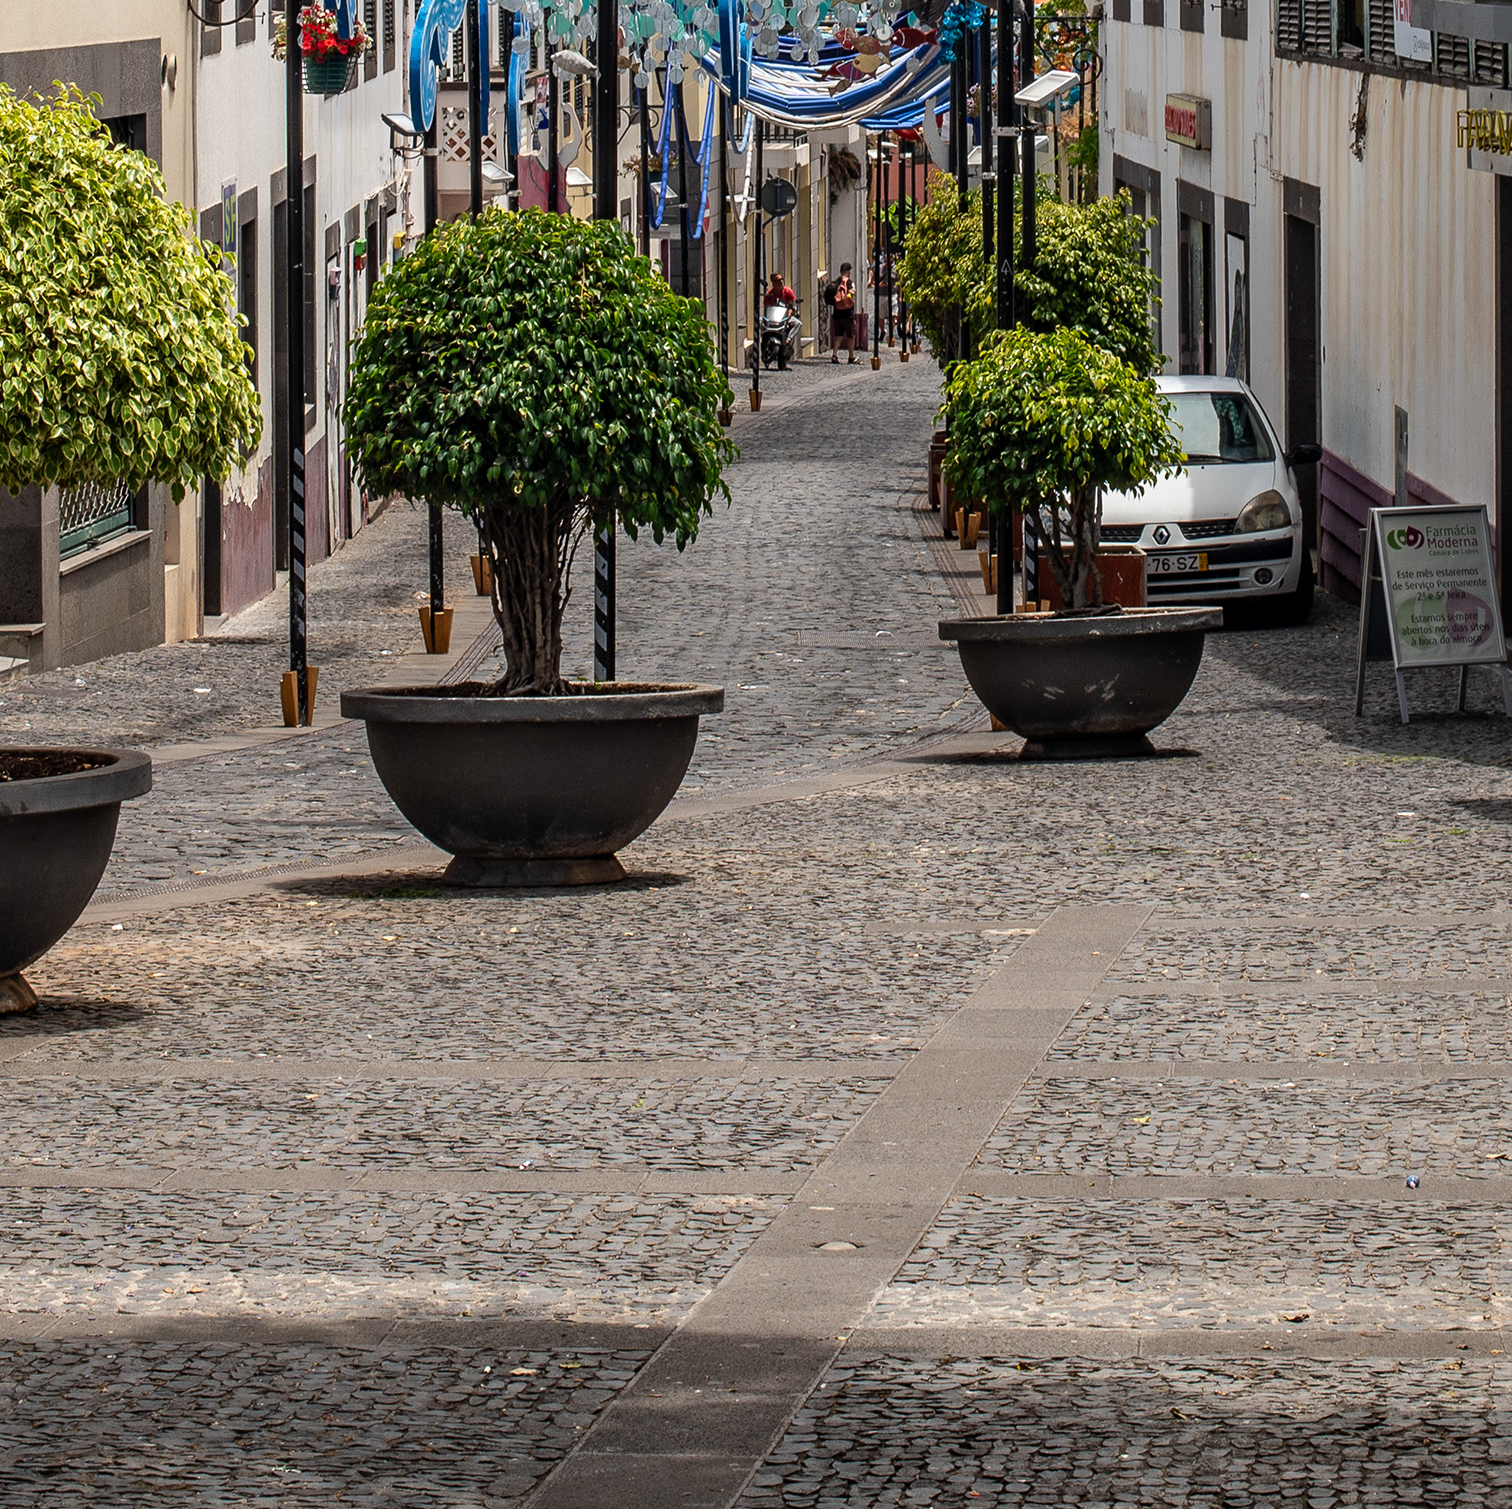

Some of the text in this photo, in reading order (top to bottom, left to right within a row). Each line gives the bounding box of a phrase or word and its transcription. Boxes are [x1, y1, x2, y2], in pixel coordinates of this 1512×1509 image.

[1426, 524, 1477, 537] Farmácia
[1427, 537, 1478, 549] Moderna
[1429, 549, 1451, 557] Câmara
[1397, 568, 1479, 579] Este mês estaremos
[1392, 578, 1487, 591] de Serviço Permanente
[1411, 612, 1478, 623] Estamos sempre
[1402, 622, 1490, 635] abertos nos dias úteis
[1411, 634, 1482, 647] à hora do almoço
